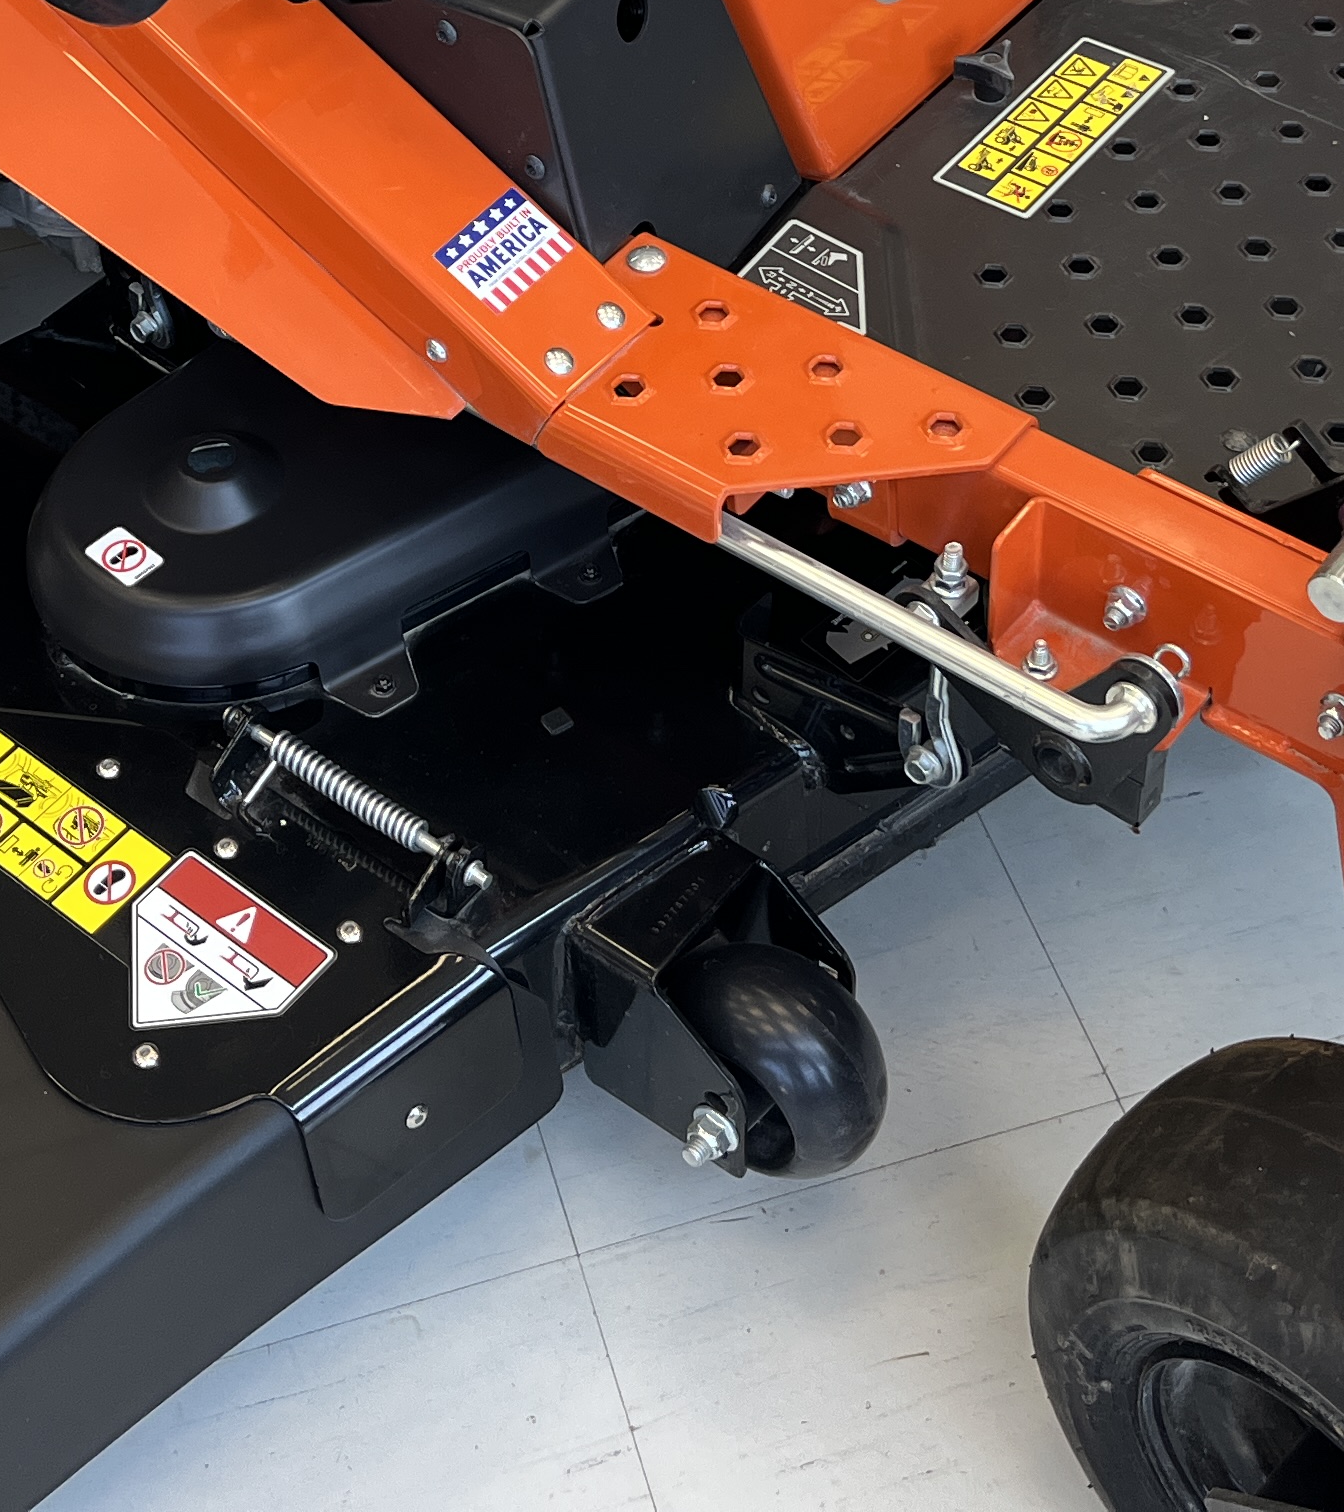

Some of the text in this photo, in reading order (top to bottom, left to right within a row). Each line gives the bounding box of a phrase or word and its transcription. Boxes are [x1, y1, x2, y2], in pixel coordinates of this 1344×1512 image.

[456, 207, 532, 273] PROUDLY BUILT IN
[467, 217, 548, 289] AMERICA
